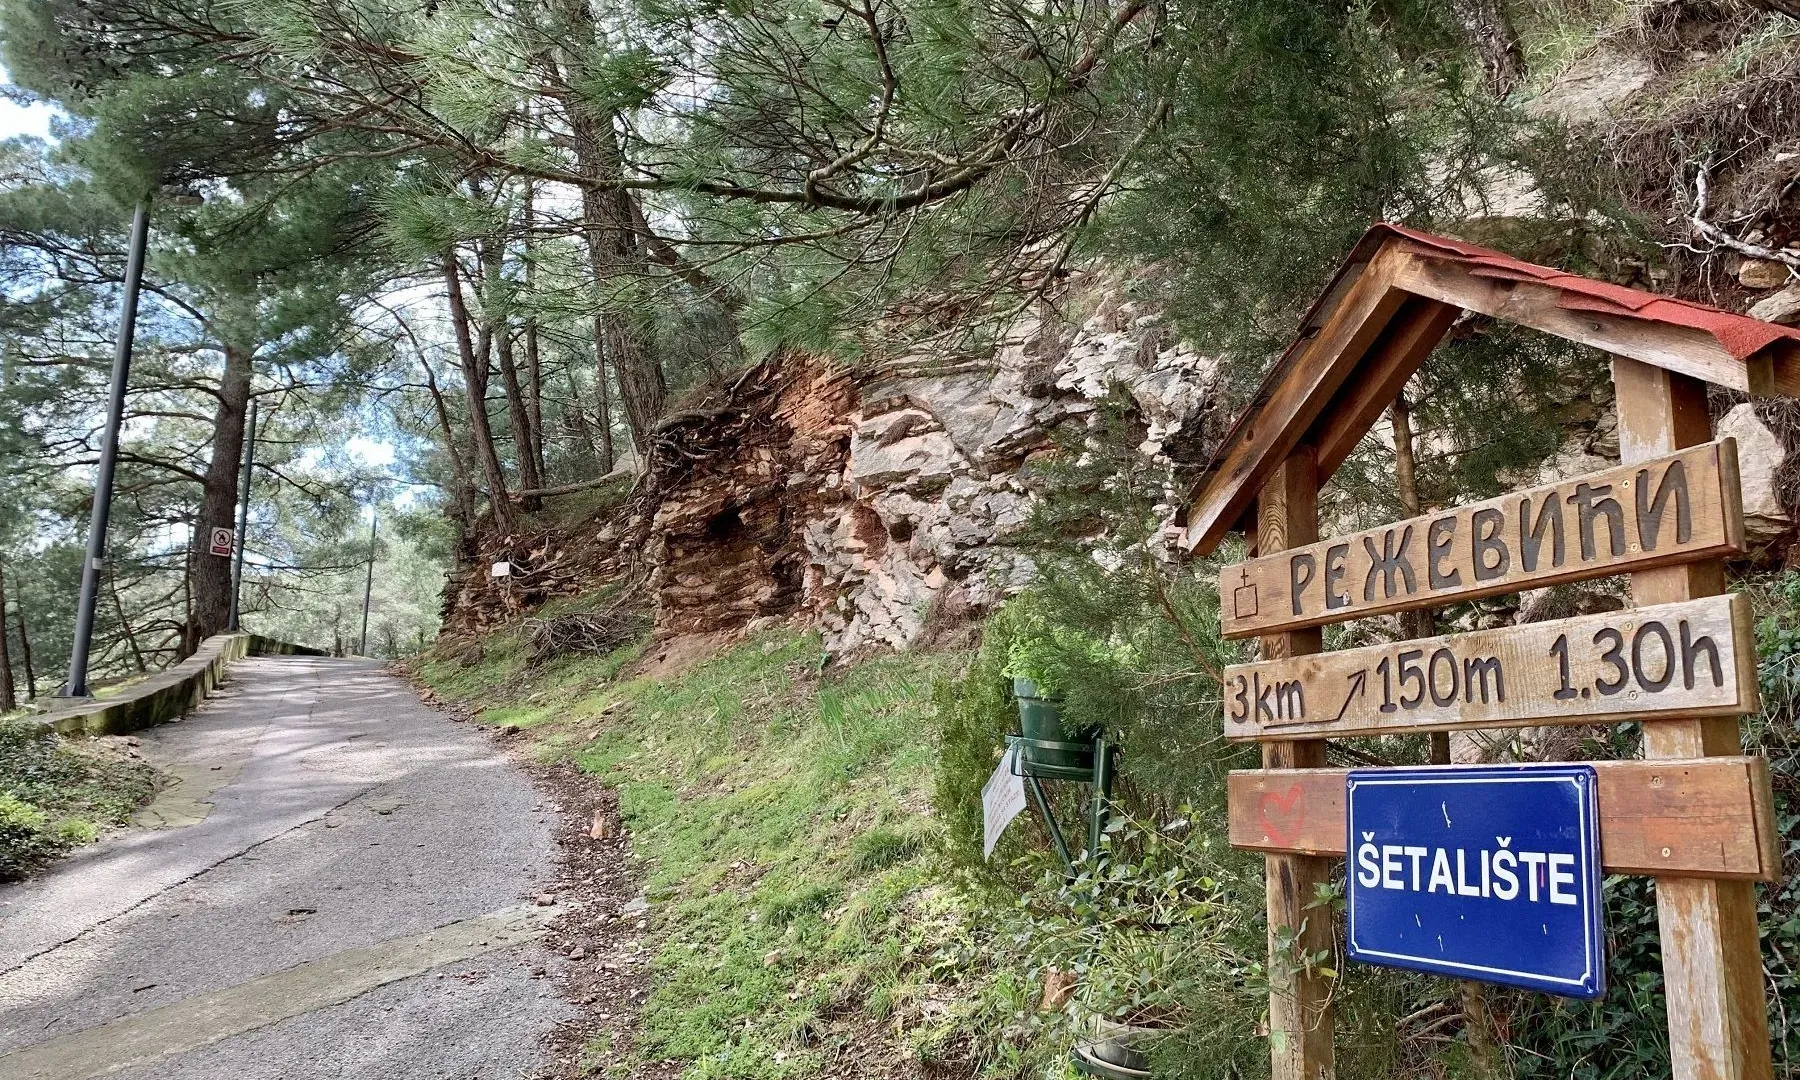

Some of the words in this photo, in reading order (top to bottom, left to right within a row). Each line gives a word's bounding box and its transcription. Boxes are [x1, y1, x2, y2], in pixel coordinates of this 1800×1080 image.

[1290, 460, 1692, 616] РЕЖЕВИЋИ
[1376, 647, 1504, 714] 150m
[1549, 619, 1724, 701] 1.30h
[1357, 831, 1578, 906] ŠETALIŠTE
